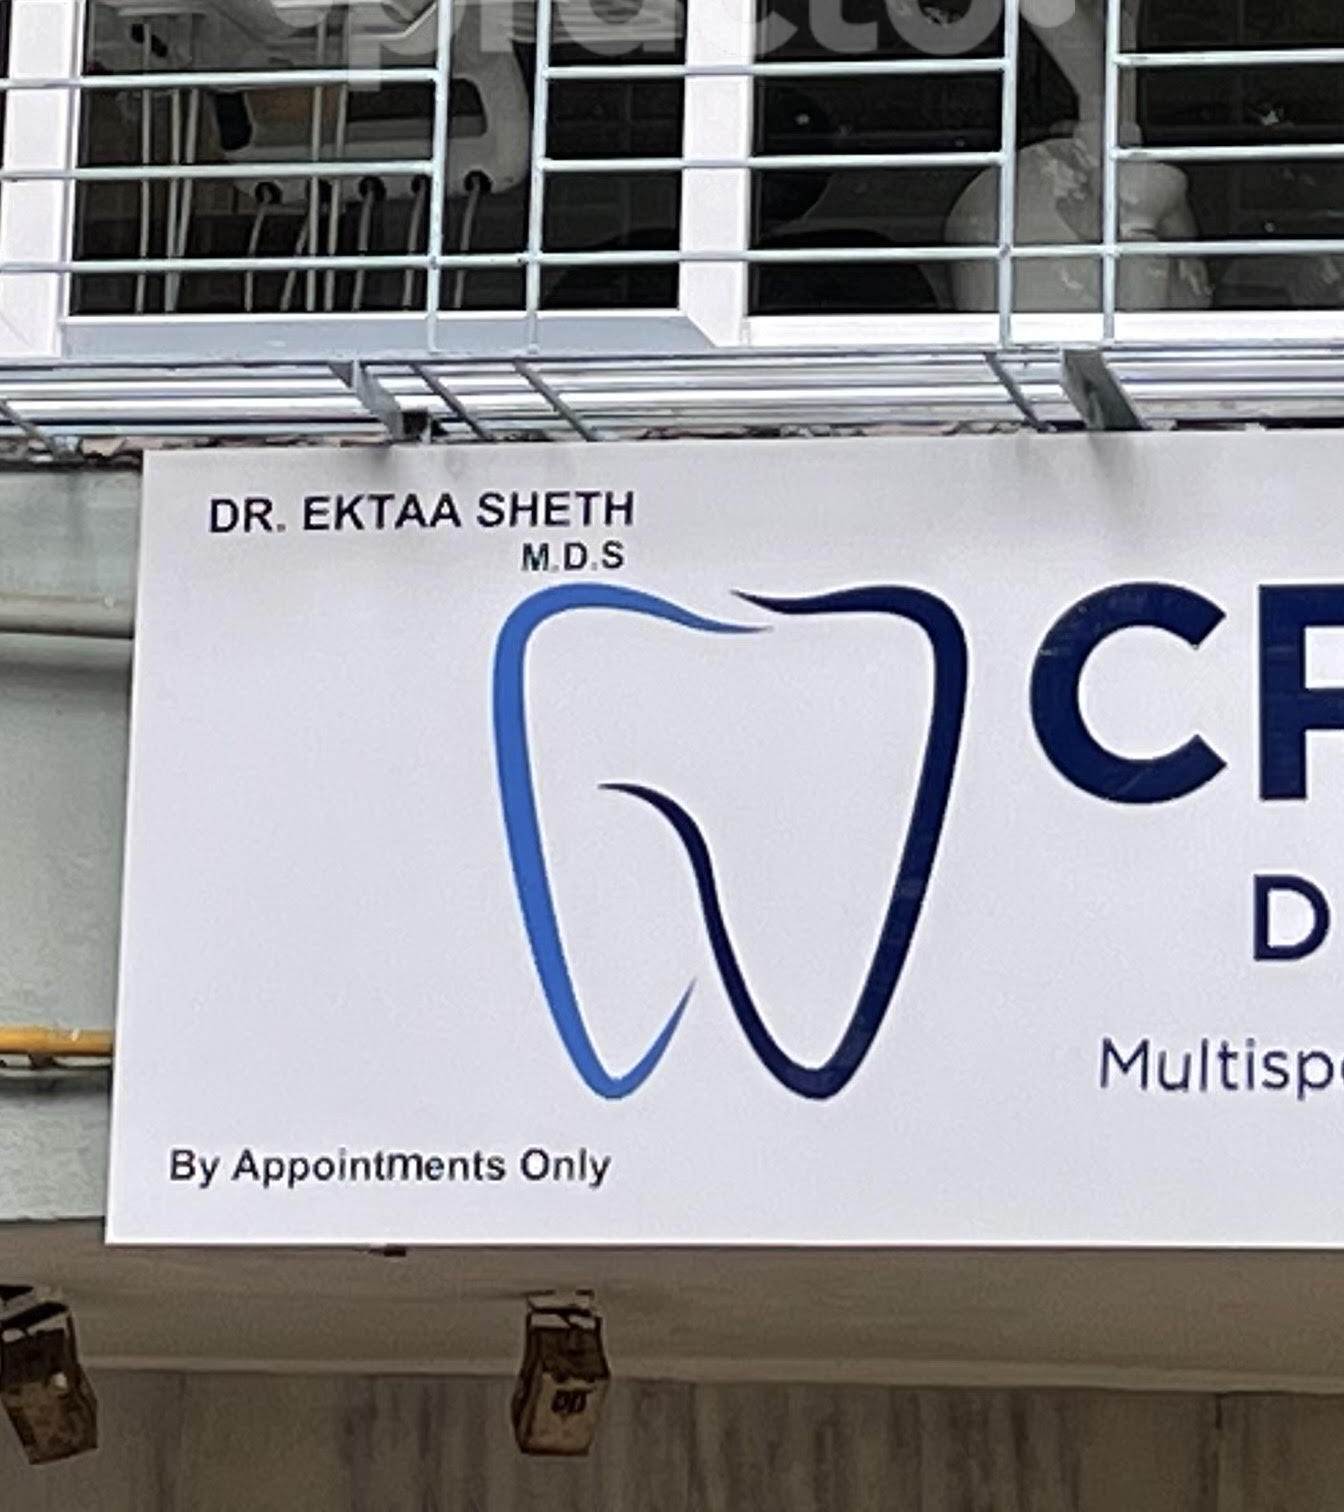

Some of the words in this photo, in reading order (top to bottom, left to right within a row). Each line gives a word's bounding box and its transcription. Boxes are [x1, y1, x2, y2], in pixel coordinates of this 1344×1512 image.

[209, 497, 287, 534] DR.
[302, 493, 463, 532] EKTAA
[476, 490, 634, 529] SHETH
[521, 539, 625, 572] M.D.S
[169, 1148, 221, 1189] By
[230, 1147, 507, 1189] Appointments
[520, 1147, 612, 1188] Only
